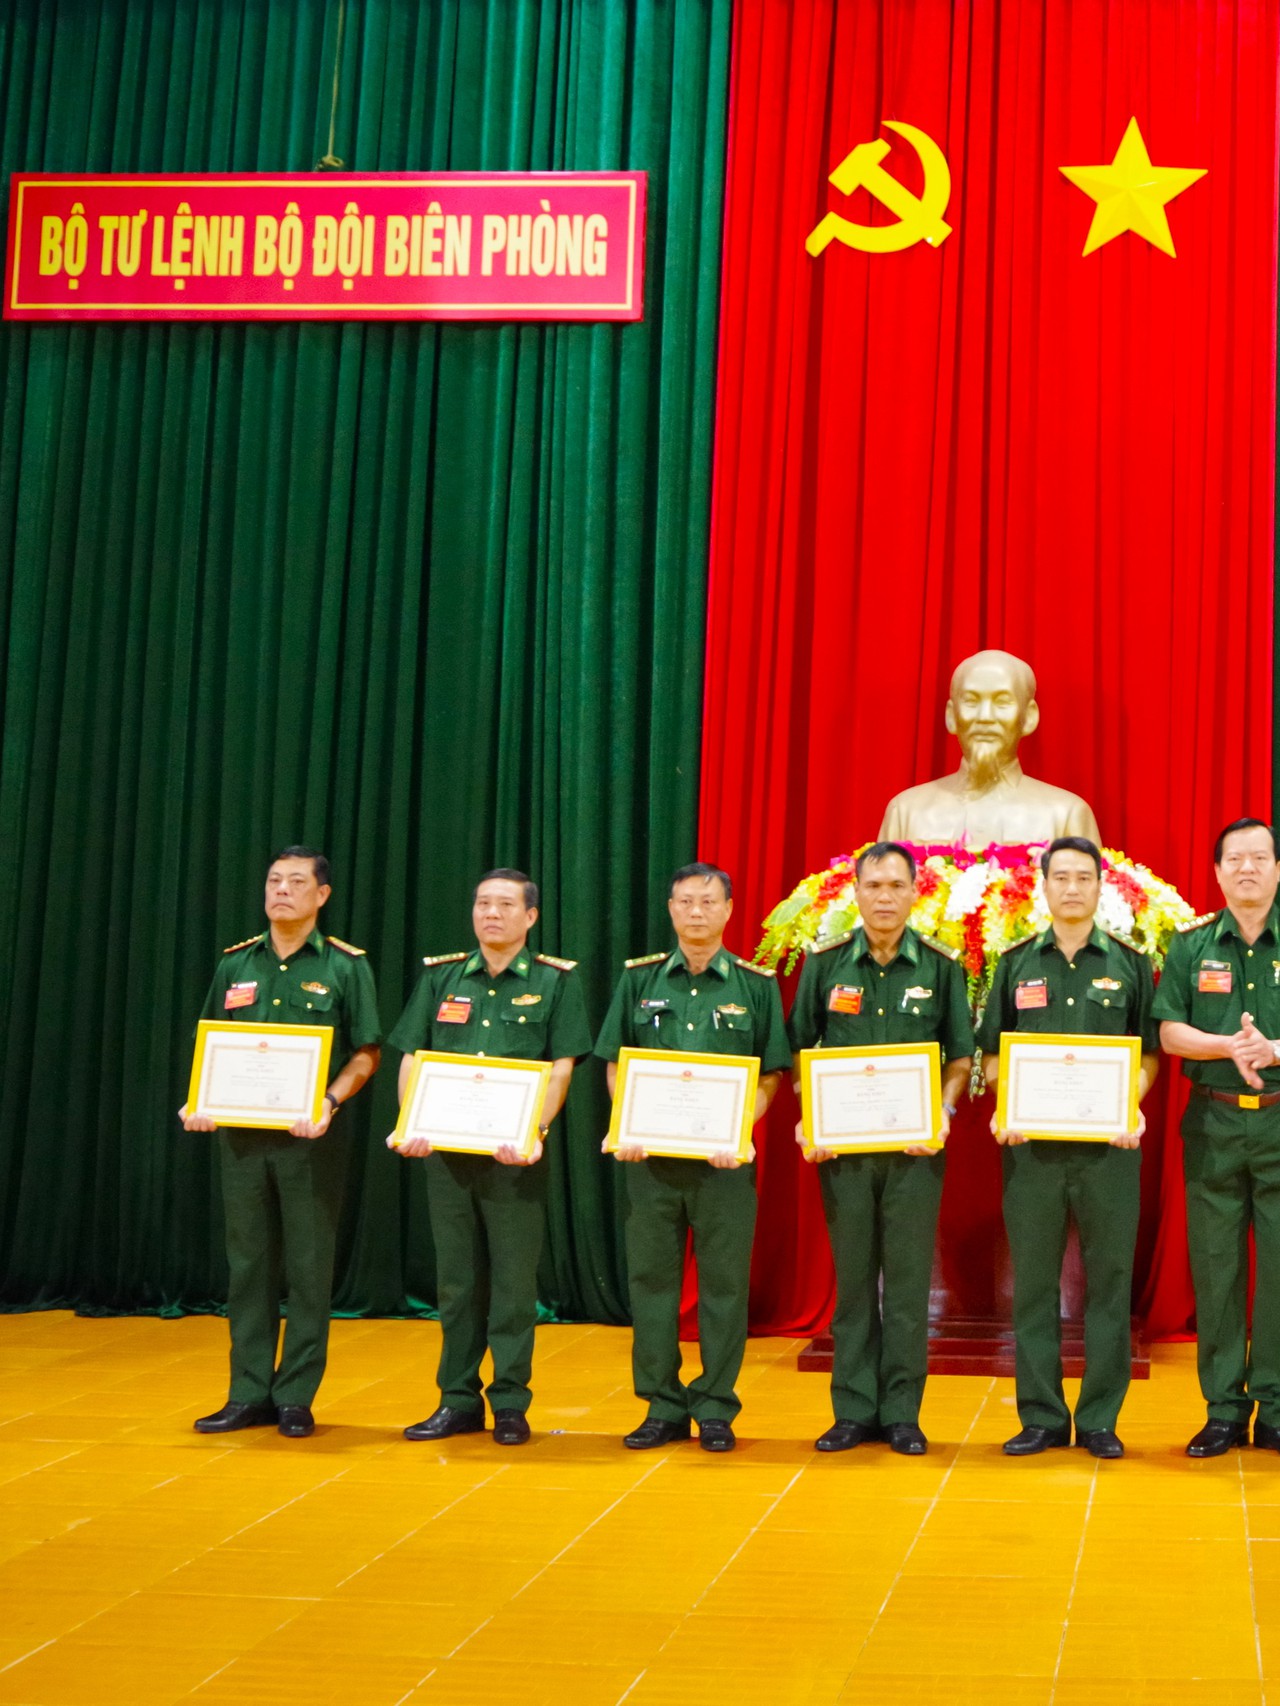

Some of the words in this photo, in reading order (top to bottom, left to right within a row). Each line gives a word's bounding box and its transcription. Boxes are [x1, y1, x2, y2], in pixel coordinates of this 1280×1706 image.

[39, 203, 87, 290] BỘ
[99, 209, 148, 277] TƯ
[152, 202, 246, 290] LỆNH
[254, 202, 303, 290] BỘ
[312, 202, 374, 290] ĐỘI
[384, 202, 472, 277] BIÊN
[481, 200, 608, 277] PHÒNG
